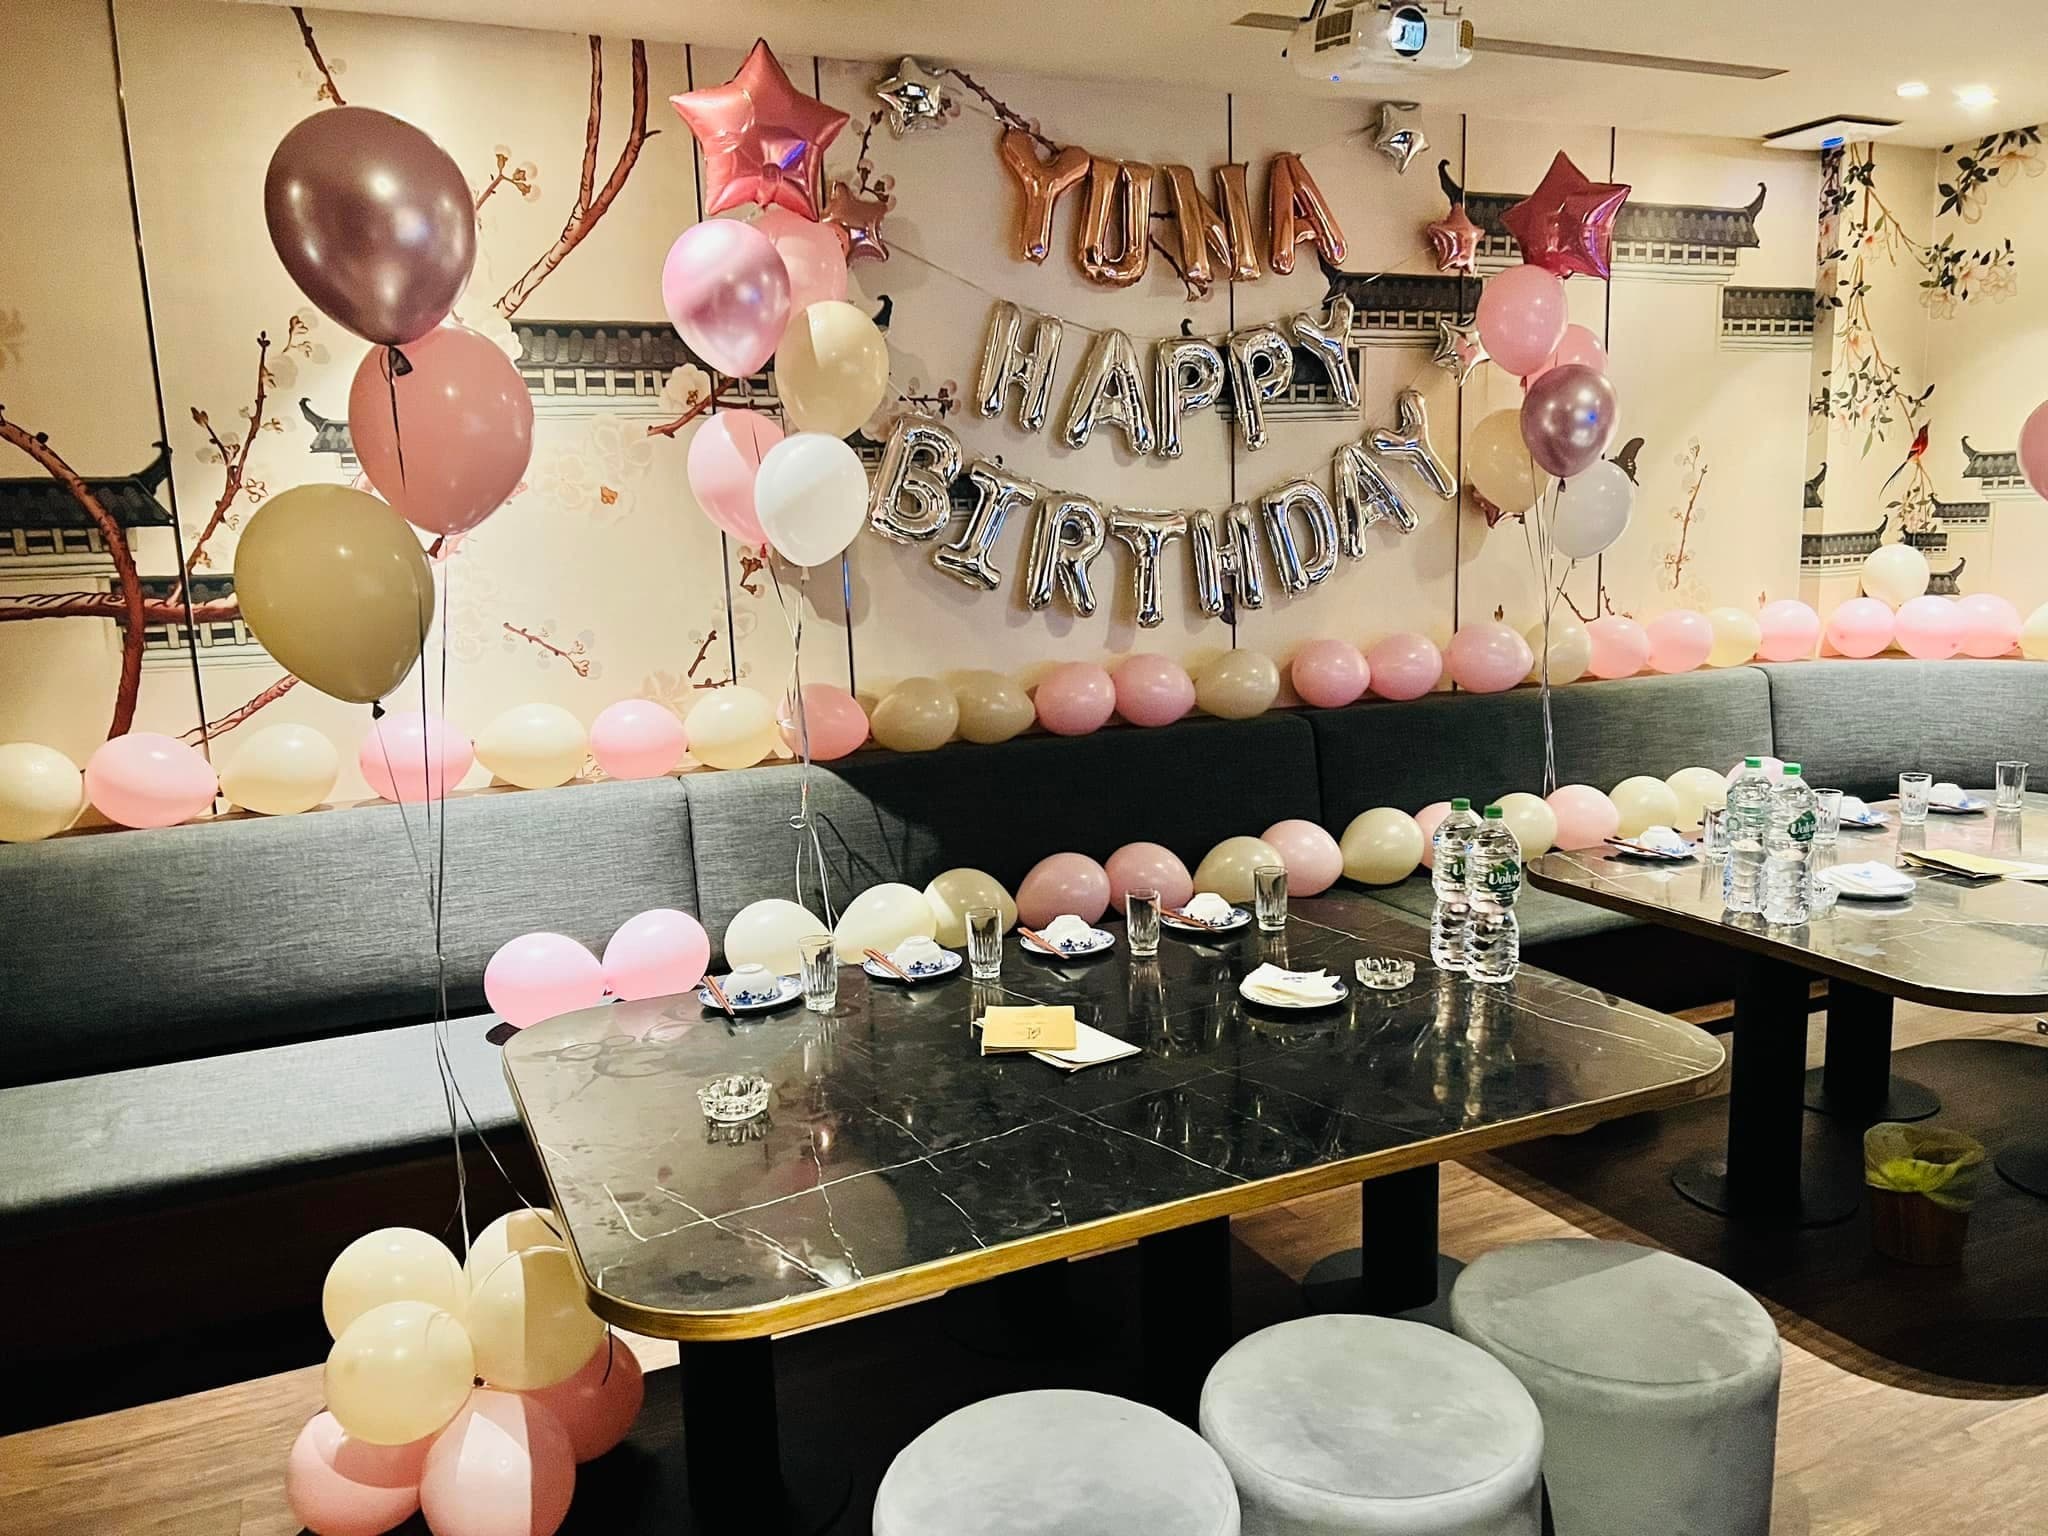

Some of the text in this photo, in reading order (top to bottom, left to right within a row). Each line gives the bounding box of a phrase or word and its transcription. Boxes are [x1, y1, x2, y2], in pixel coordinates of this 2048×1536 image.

[1001, 127, 1348, 287] YUNA
[978, 293, 1360, 458] HAPPY
[868, 390, 1457, 627] BIRTHDAY
